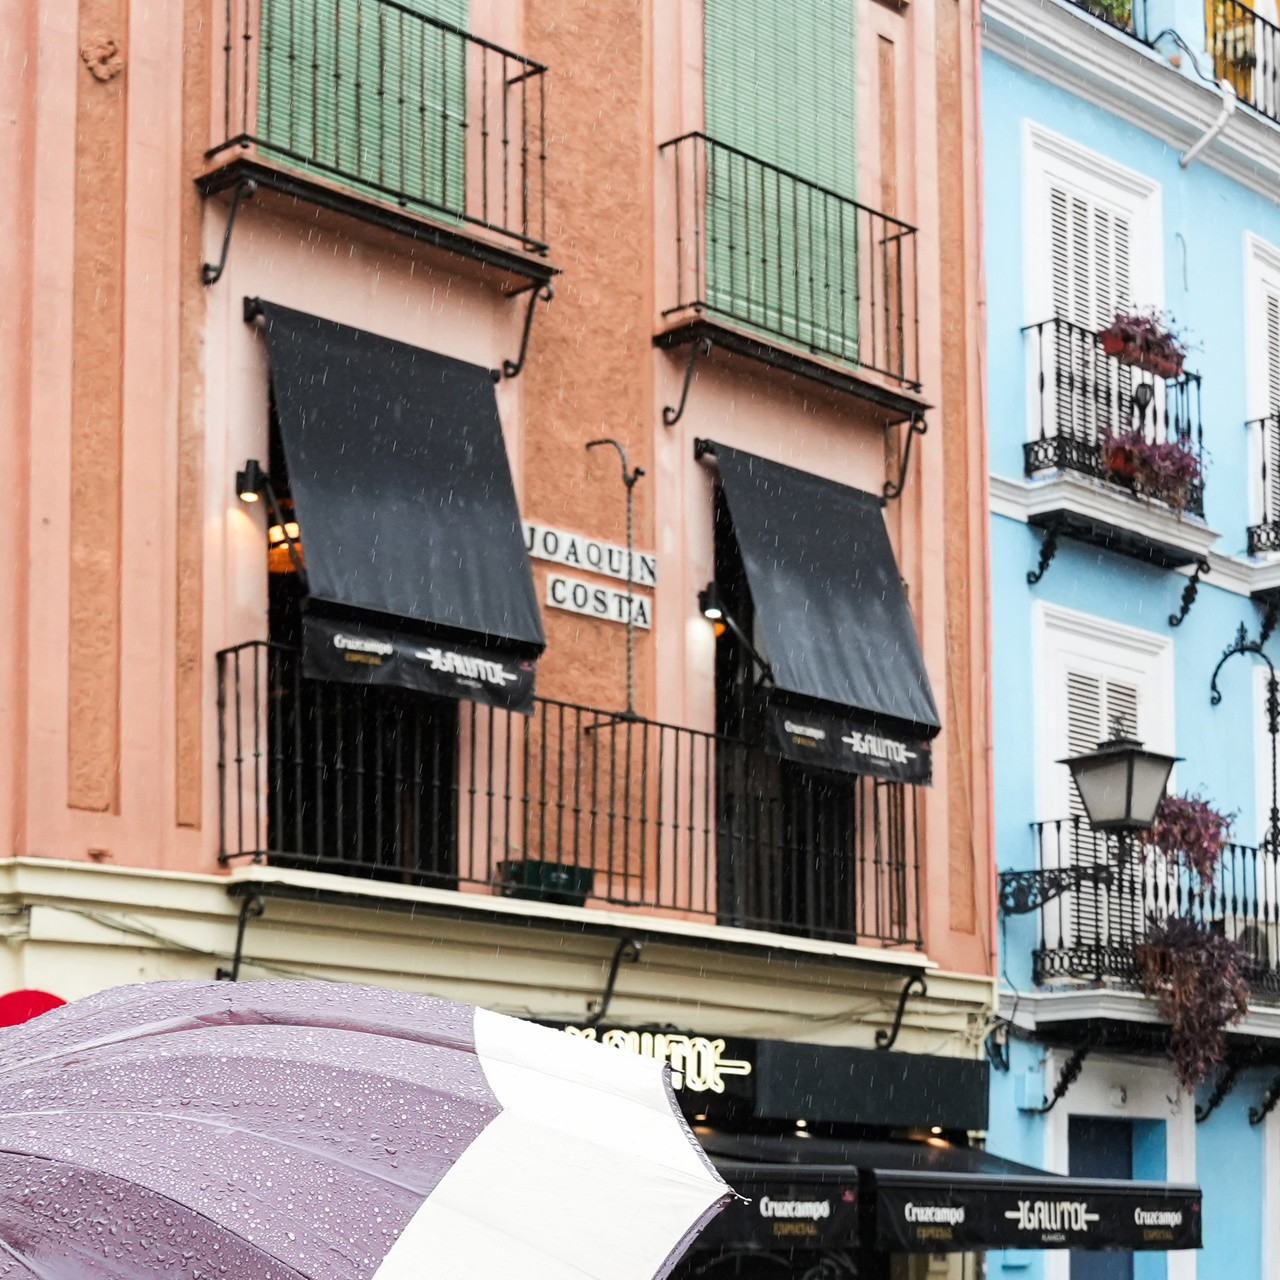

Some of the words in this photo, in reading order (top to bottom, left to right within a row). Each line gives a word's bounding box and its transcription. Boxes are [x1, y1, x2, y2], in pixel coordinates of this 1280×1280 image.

[526, 526, 657, 584] JOAQUN
[551, 578, 649, 625] COSTA
[759, 1196, 831, 1222] Cruzcampo
[904, 1202, 966, 1226] Cruzcampo
[1134, 1207, 1183, 1228] Cruzcampo
